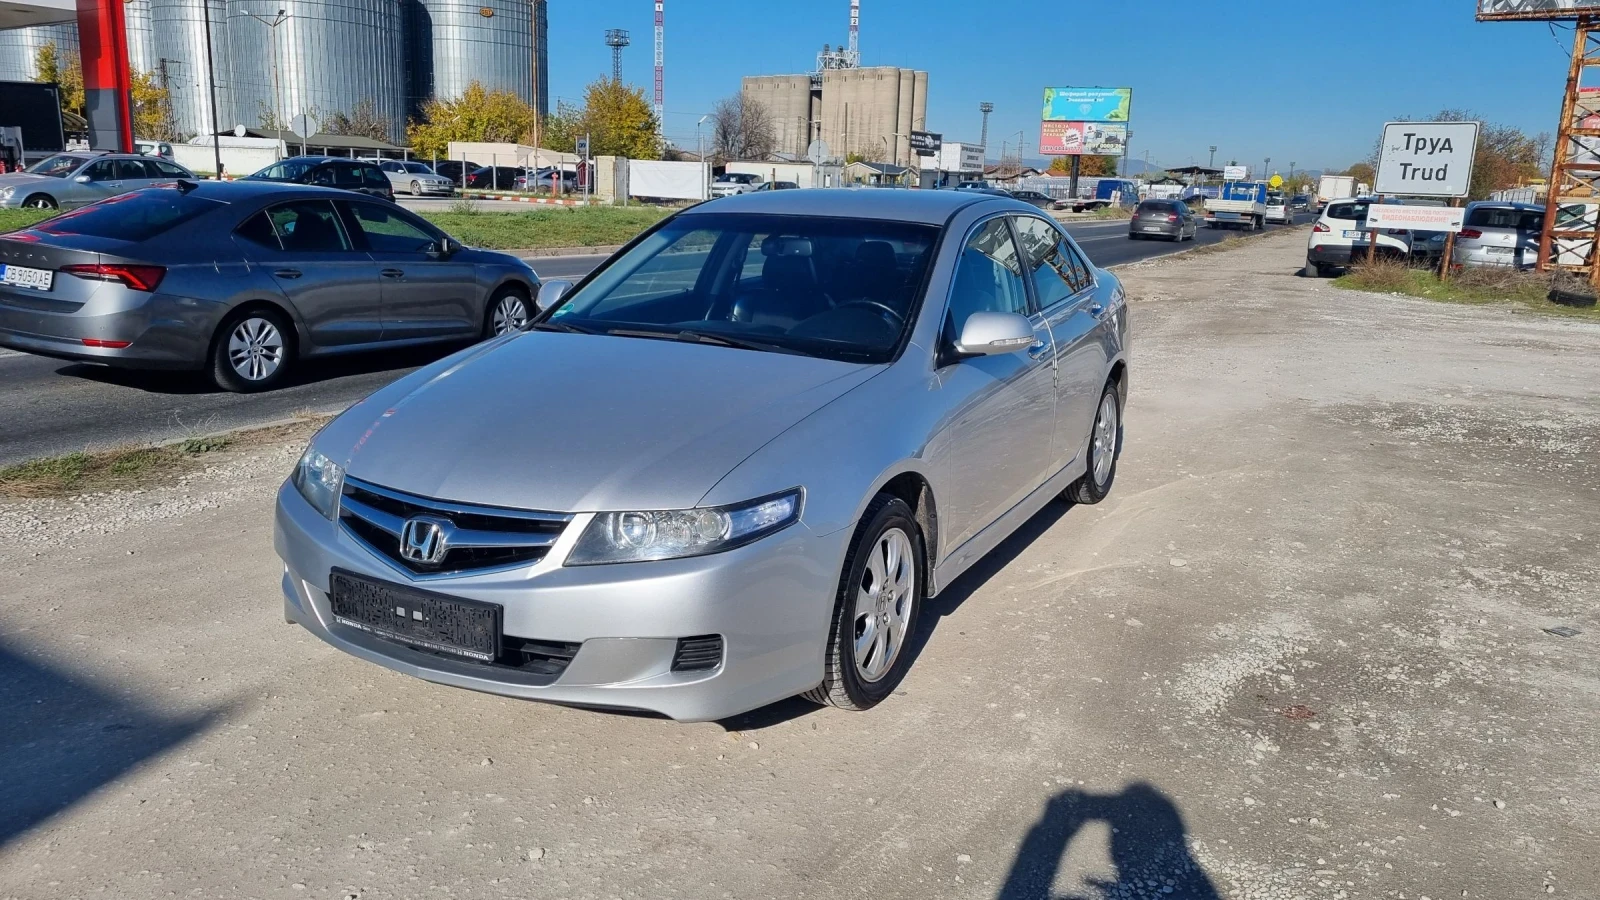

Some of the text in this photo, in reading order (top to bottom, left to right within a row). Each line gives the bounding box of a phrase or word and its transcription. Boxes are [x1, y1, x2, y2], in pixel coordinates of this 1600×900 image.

[1403, 132, 1453, 155] Труд
[1399, 163, 1448, 181] Trud
[342, 618, 362, 629] HONDA
[463, 650, 489, 660] HONDA
